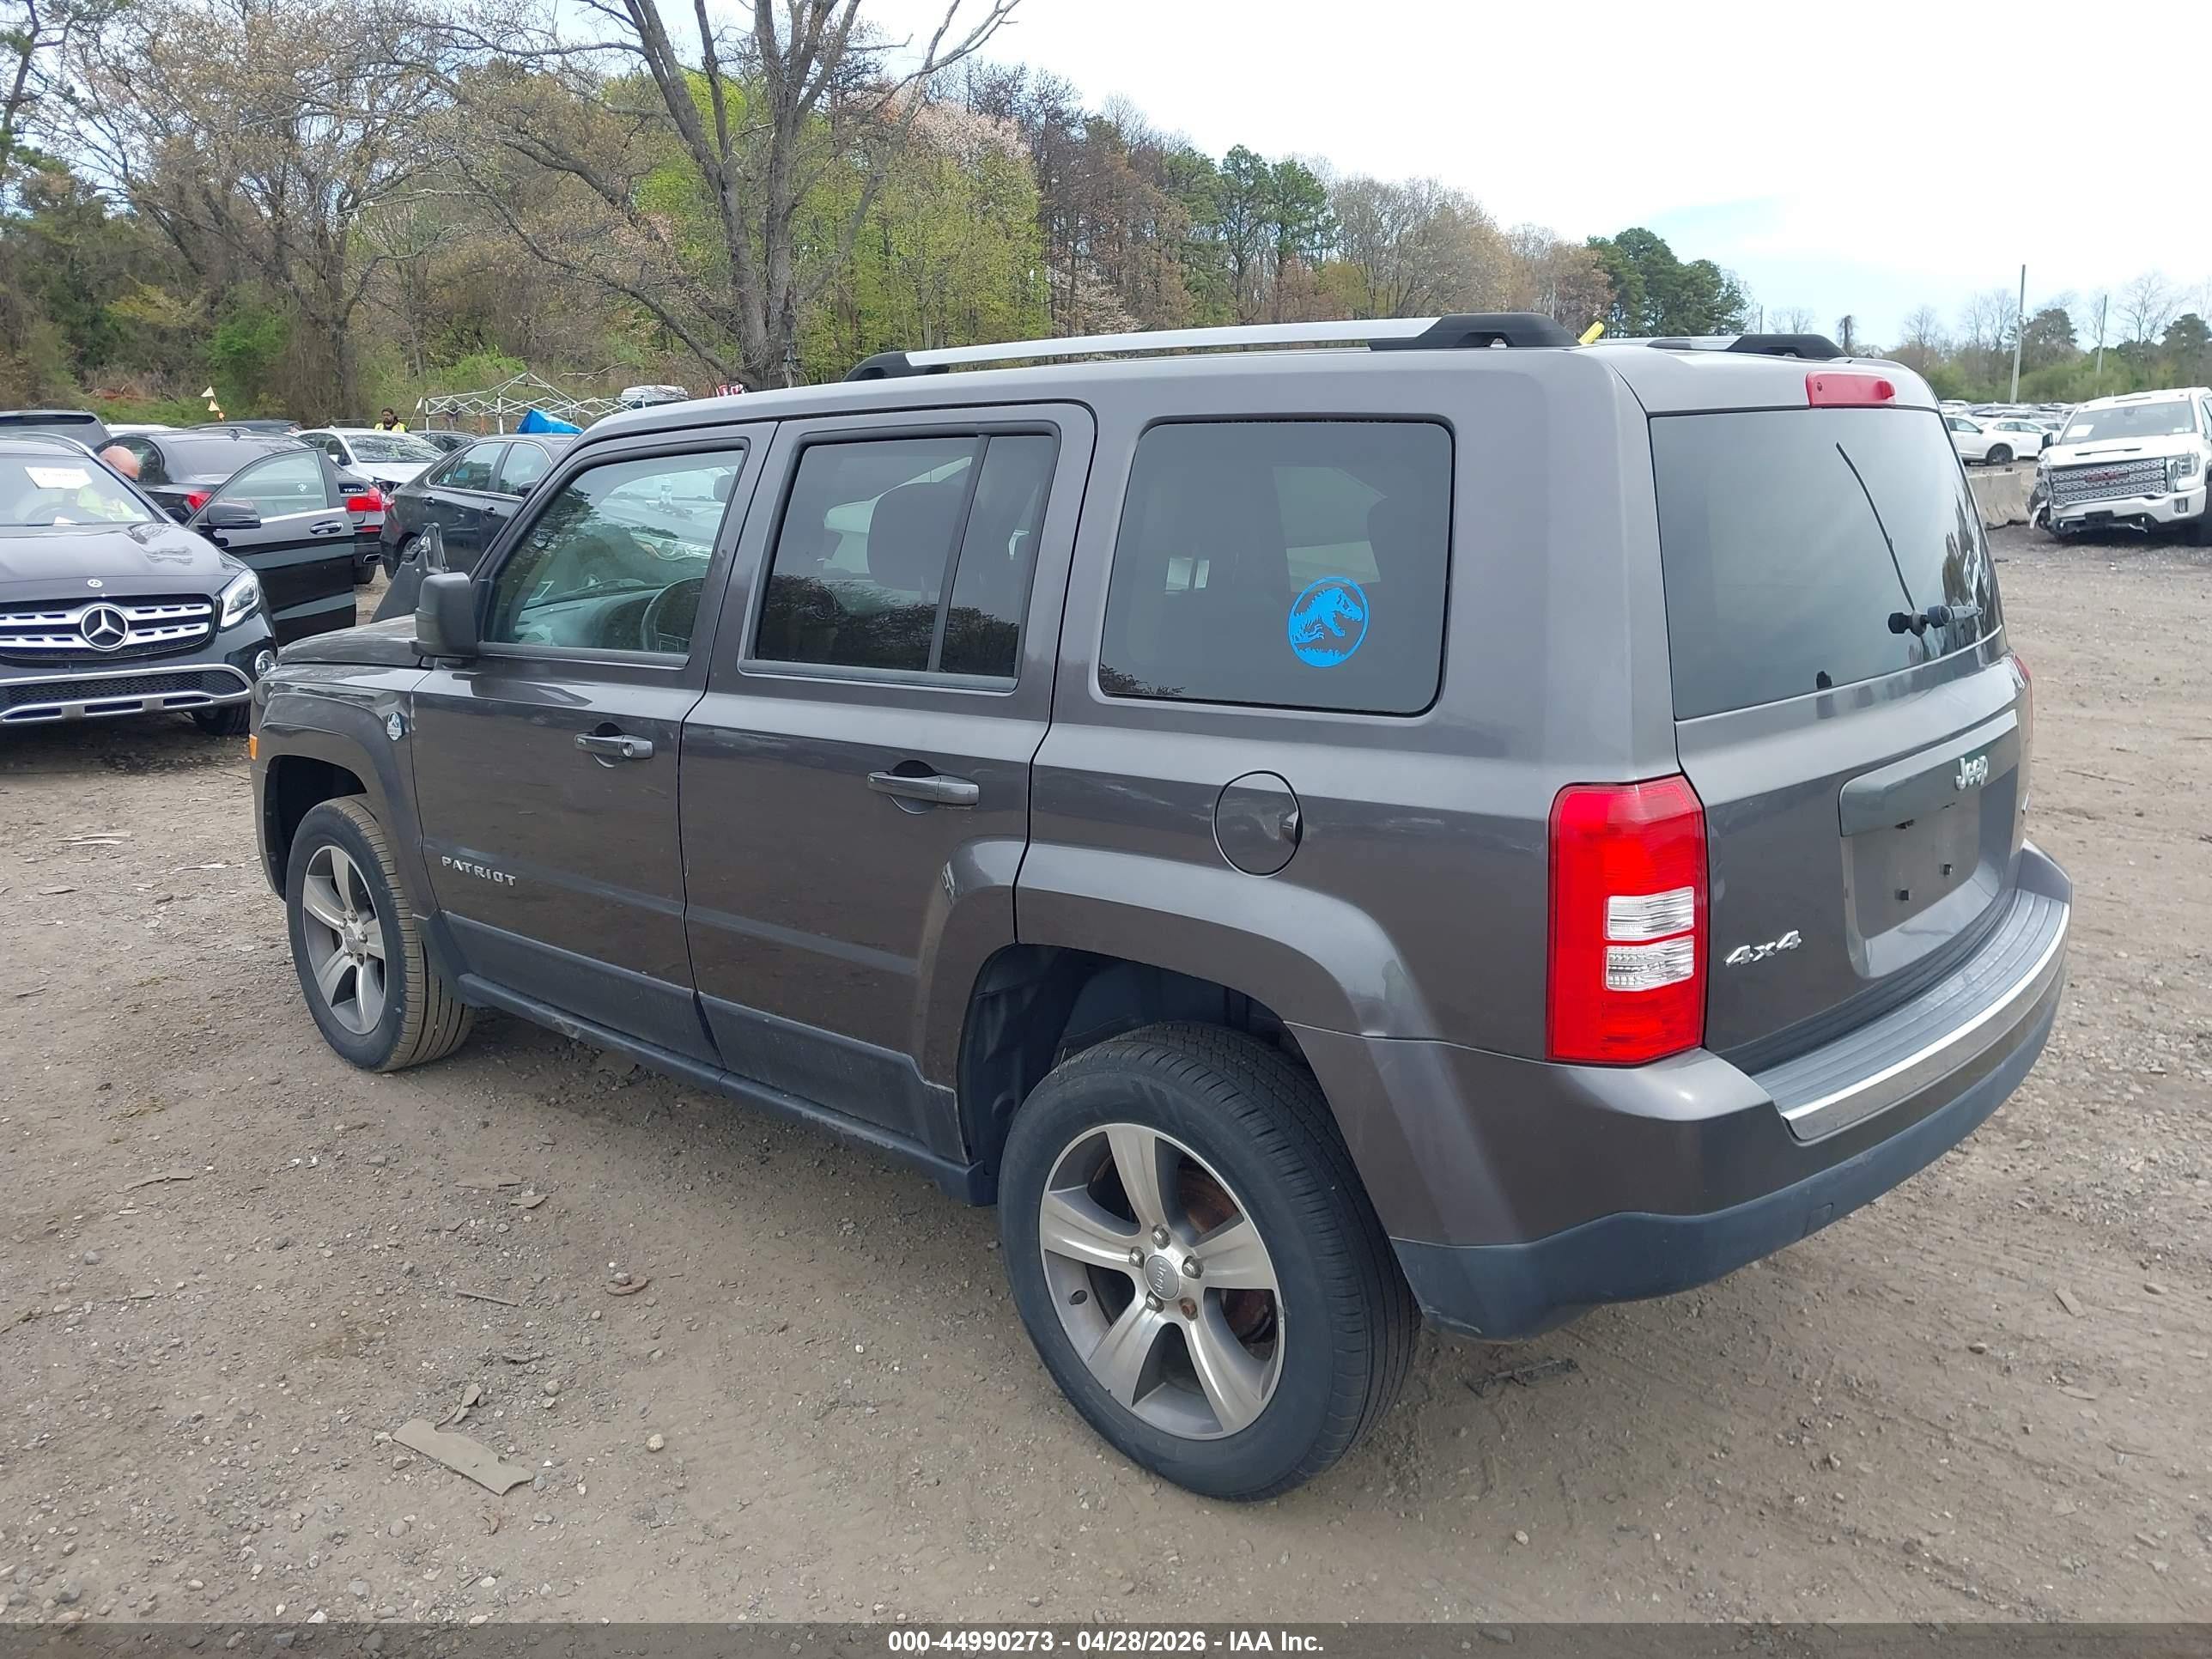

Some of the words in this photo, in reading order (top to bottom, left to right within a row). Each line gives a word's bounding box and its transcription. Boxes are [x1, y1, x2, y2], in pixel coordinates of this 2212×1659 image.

[1955, 755, 1988, 790] Jeep
[441, 855, 516, 886] PATRIOT
[1724, 929, 1802, 969] 4x4
